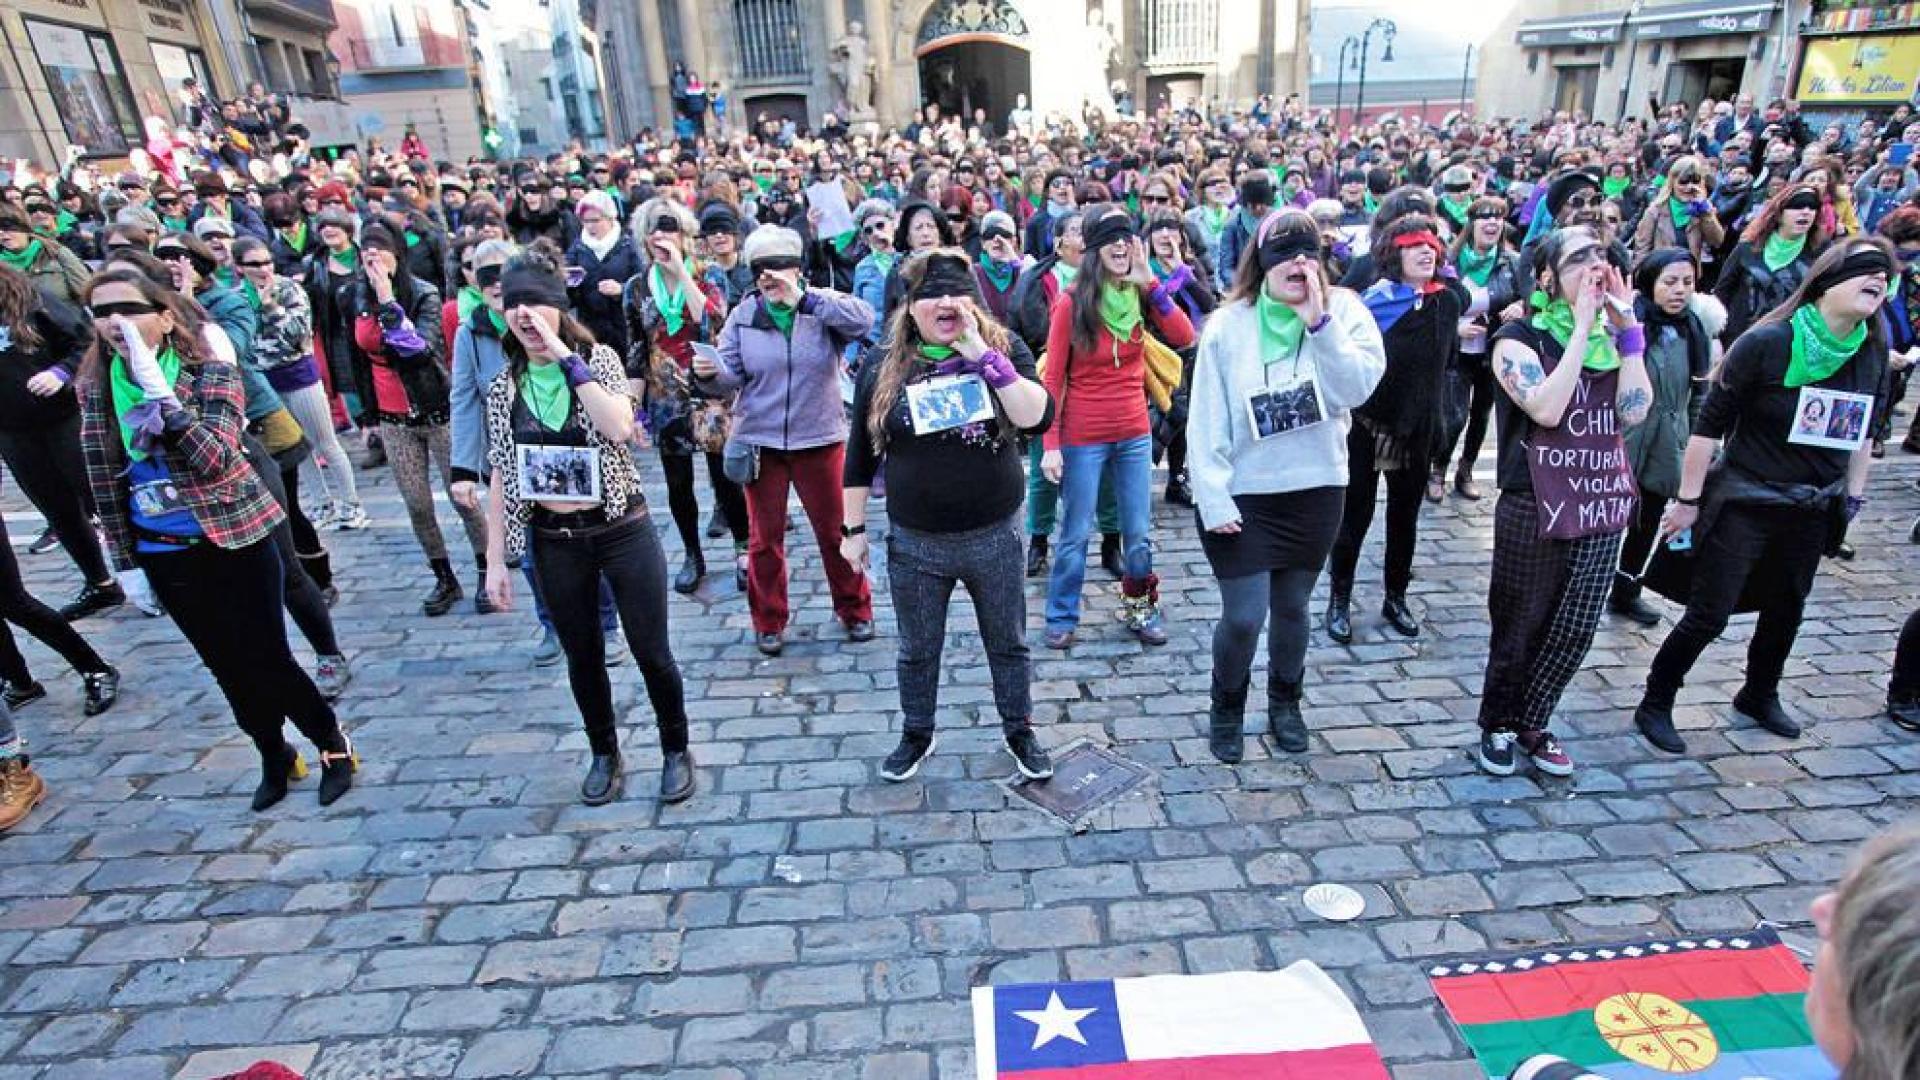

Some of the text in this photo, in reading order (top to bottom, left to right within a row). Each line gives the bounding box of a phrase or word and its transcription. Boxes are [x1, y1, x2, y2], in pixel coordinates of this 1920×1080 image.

[1575, 377, 1591, 404] N
[1568, 402, 1617, 437] CHIL
[1543, 501, 1566, 532] Y
